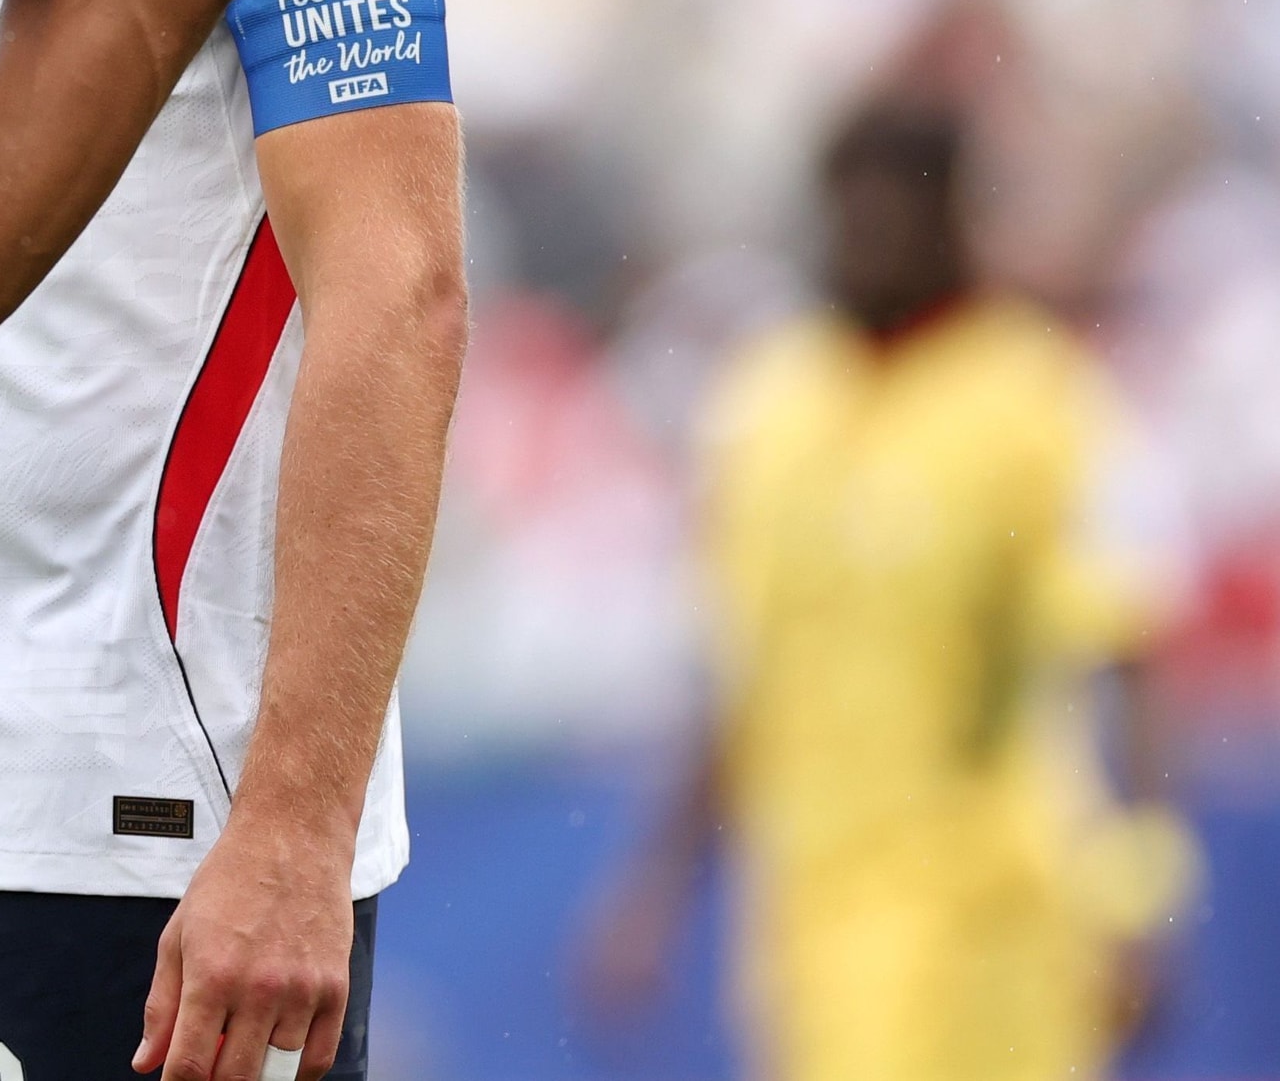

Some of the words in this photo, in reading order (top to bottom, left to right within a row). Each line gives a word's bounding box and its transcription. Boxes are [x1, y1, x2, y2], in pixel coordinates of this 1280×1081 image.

[283, 49, 334, 84] the
[336, 30, 422, 70] World
[333, 77, 385, 99] FIFA
